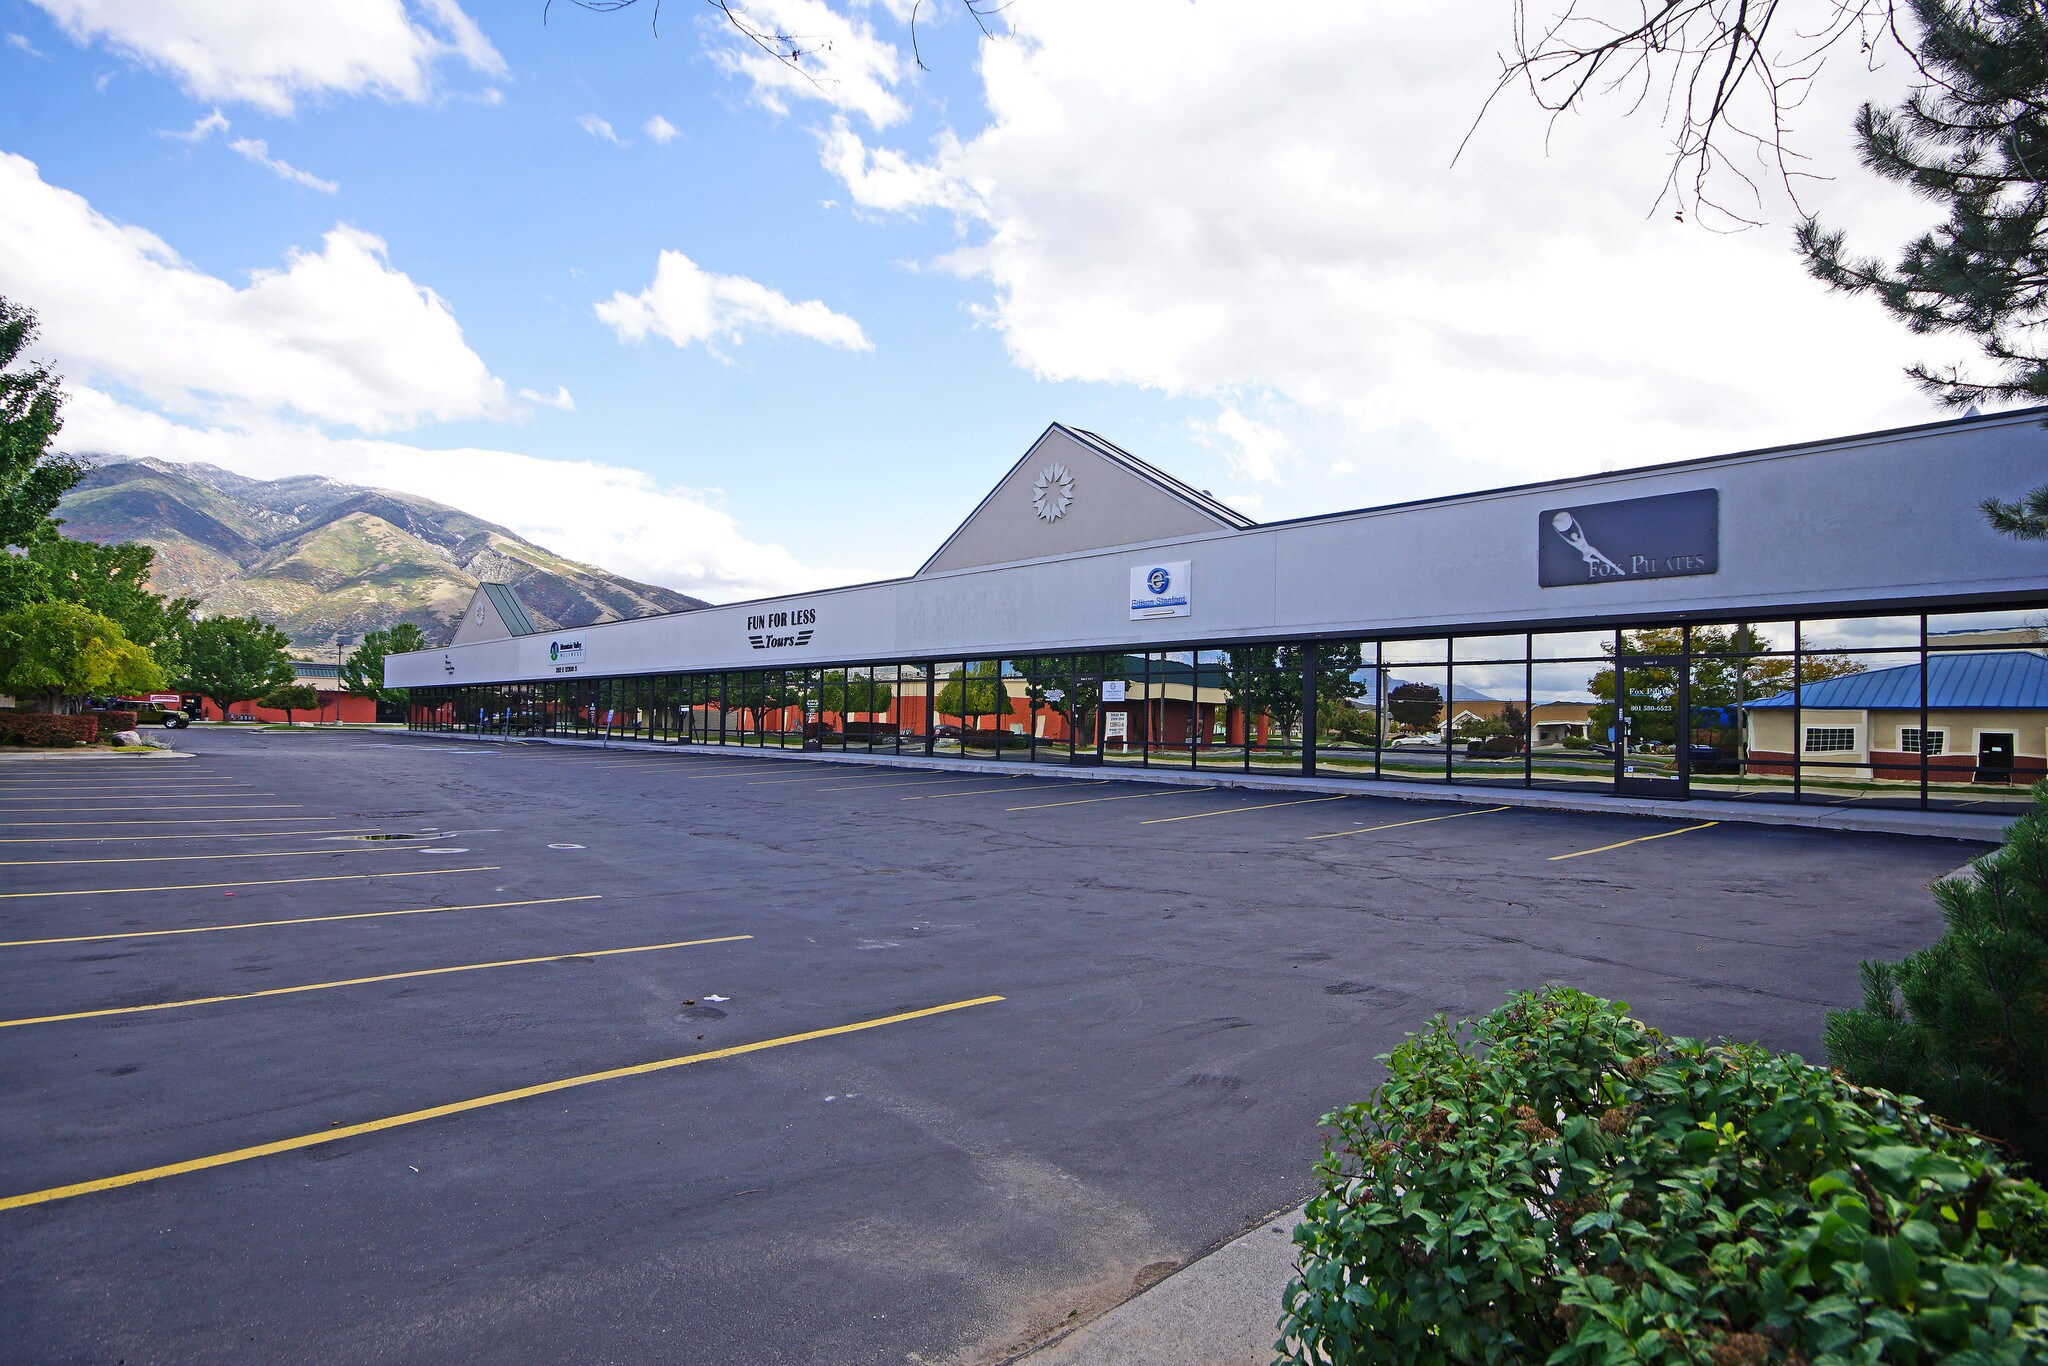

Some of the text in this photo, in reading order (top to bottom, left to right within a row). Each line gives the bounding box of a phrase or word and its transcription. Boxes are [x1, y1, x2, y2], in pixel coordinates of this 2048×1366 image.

[1631, 554, 1705, 574] PILATES
[1131, 595, 1186, 607] Edison Stanford
[747, 608, 816, 630] FUN FOR LESS
[765, 634, 795, 648] Tours
[1629, 687, 1644, 695] Fox
